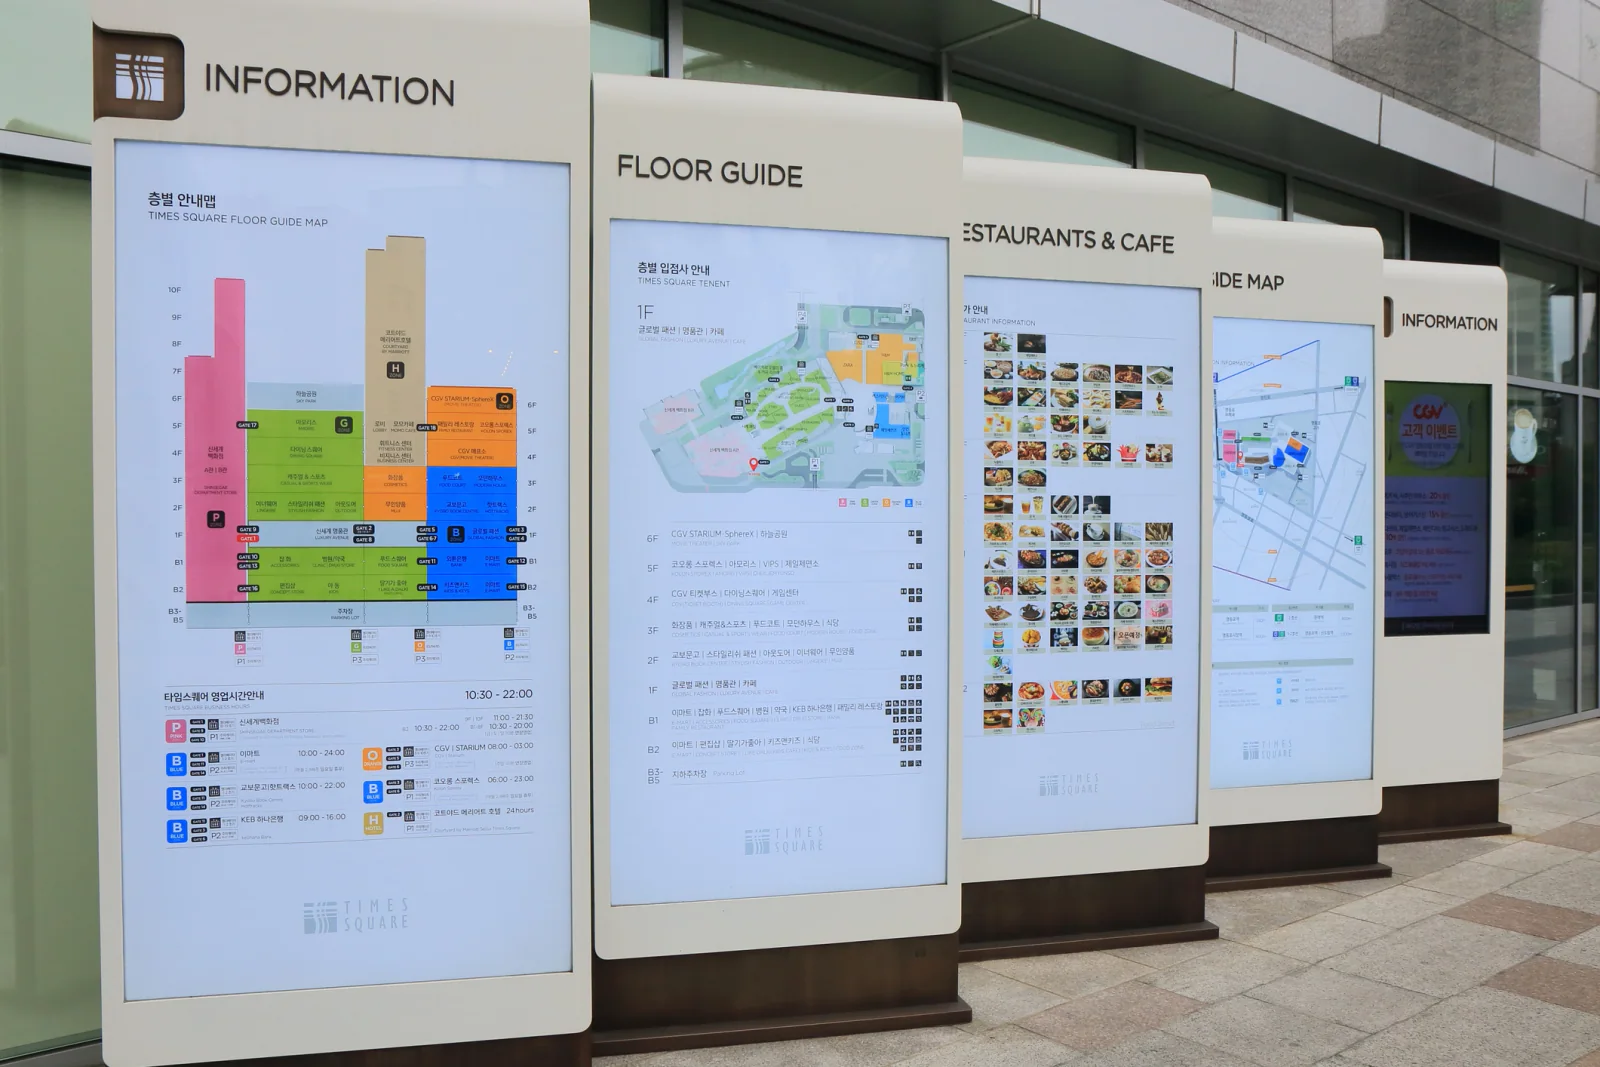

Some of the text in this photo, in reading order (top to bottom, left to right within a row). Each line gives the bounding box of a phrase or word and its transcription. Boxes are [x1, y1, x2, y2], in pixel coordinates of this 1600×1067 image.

[206, 64, 454, 106] INFORMATION
[618, 154, 803, 188] FLOOR GUIDE
[148, 192, 216, 209] 층별 안내맵
[148, 212, 328, 227] TIMES SQUARE FLOOR GUIDE MAP
[1102, 232, 1115, 250] &
[1121, 232, 1175, 253] CAFE
[638, 262, 710, 276] 층별 입점사 안내
[664, 278, 696, 286] SQUARE
[1212, 272, 1284, 290] IDE MAP
[637, 304, 654, 319] 1F
[973, 305, 988, 315] 안내
[1402, 313, 1498, 331] INFORMATION
[638, 325, 660, 335] 글로벌
[661, 326, 676, 335] 패션
[710, 328, 724, 336] 카페
[392, 364, 400, 373] H
[1413, 403, 1443, 419] CGV
[340, 419, 348, 428] G
[1402, 424, 1457, 439] 고객 이벤트
[213, 513, 220, 522] P
[760, 530, 788, 539] 하늘공원
[672, 680, 757, 689] 글로벌 패션 명품관 카페
[164, 690, 264, 702] 타임스퀘어 영업시간안내
[465, 689, 533, 700] 10:30 22:00
[672, 708, 693, 717] 이마트
[172, 723, 181, 732] P
[240, 718, 279, 726] 신세계백화점
[672, 740, 693, 749] 이마트
[172, 756, 181, 766] B
[672, 770, 707, 779] 지하주차장
[369, 784, 378, 794] B
[173, 790, 182, 800] B
[369, 815, 378, 824] H
[173, 823, 182, 832] B
[775, 825, 823, 839] TIMES
[775, 840, 823, 855] SQUARE
[344, 898, 408, 914] TIMES
[344, 914, 408, 933] SQUARE
